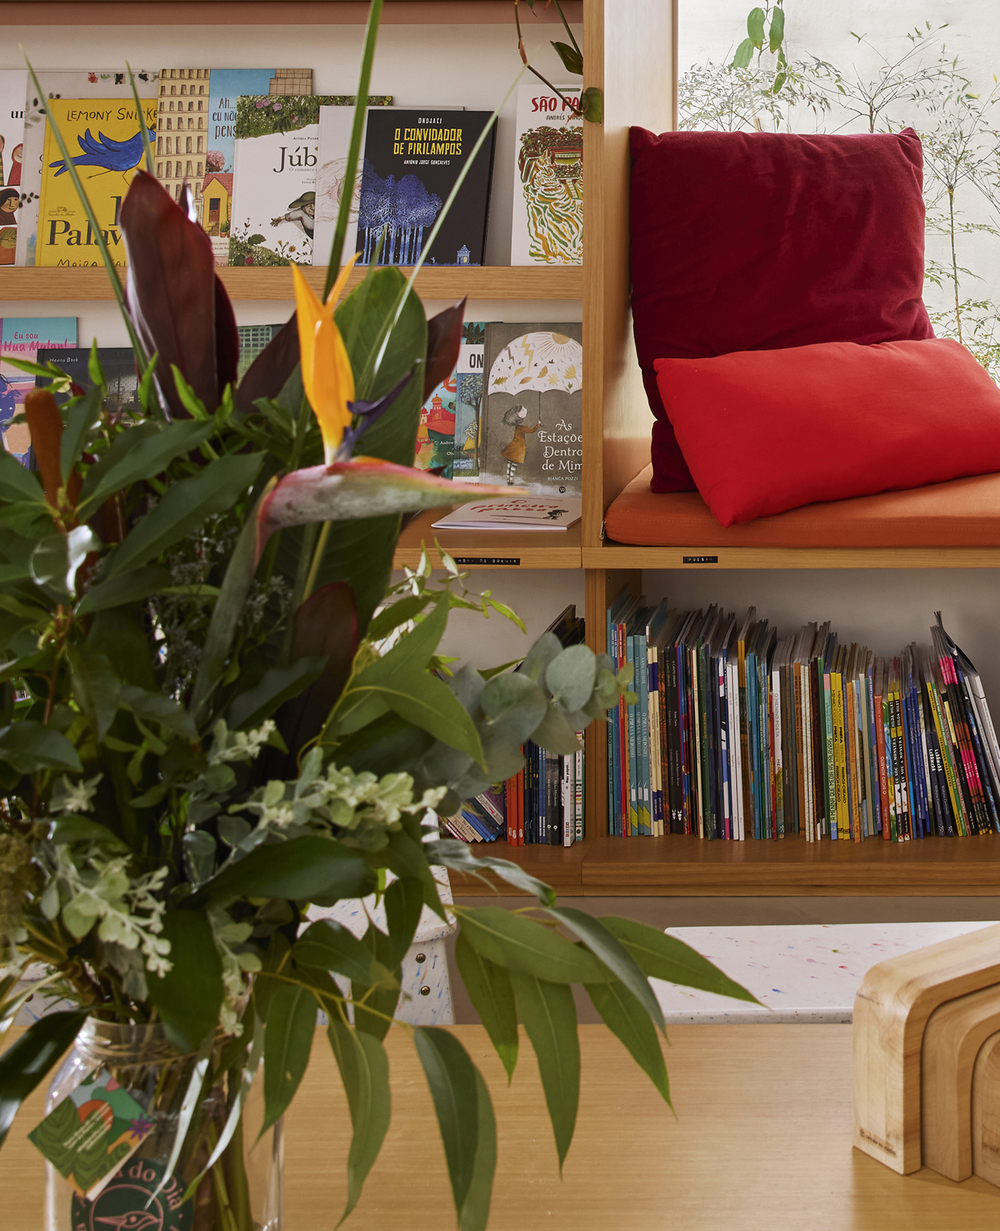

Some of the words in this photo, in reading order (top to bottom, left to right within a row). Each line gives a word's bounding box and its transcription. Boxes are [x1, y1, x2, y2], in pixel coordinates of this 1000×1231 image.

[218, 98, 236, 109] Ah...
[531, 95, 557, 113] SÃO
[67, 110, 112, 122] LEMONY
[212, 112, 222, 121] eu
[394, 129, 401, 141] O
[404, 128, 462, 141] CONVIDADOR
[393, 143, 403, 154] DE
[408, 143, 462, 155] PIRILAMPOS
[14, 332, 23, 340] Eu
[4, 340, 26, 351] Hua
[555, 420, 573, 430] As
[543, 446, 583, 458] Dentro
[542, 461, 555, 471] de
[128, 1161, 156, 1182] do
